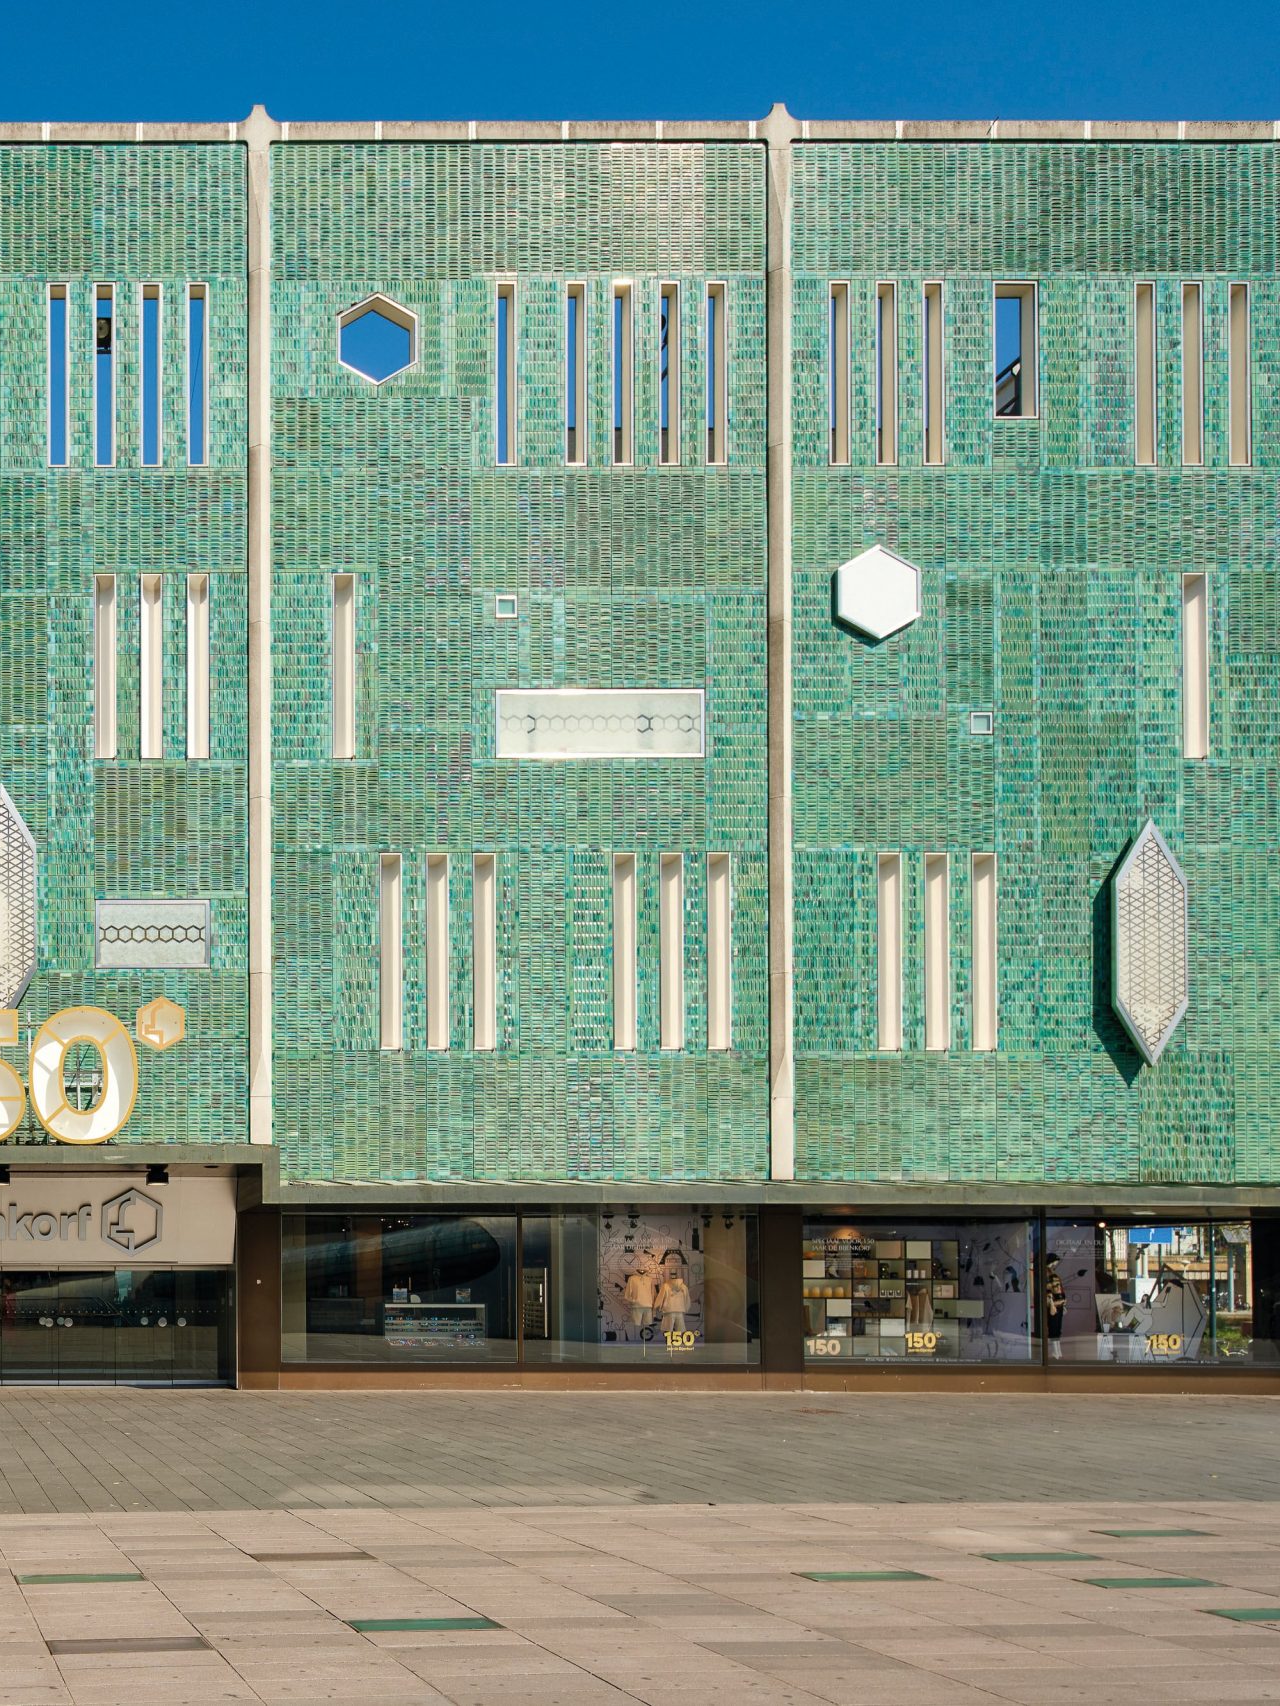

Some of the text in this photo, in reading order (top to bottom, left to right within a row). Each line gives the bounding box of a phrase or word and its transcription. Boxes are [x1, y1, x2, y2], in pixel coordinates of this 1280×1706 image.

[663, 1330, 695, 1347] 150
[905, 1332, 936, 1349] 150
[1149, 1334, 1181, 1350] 150
[806, 1339, 841, 1356] 150
